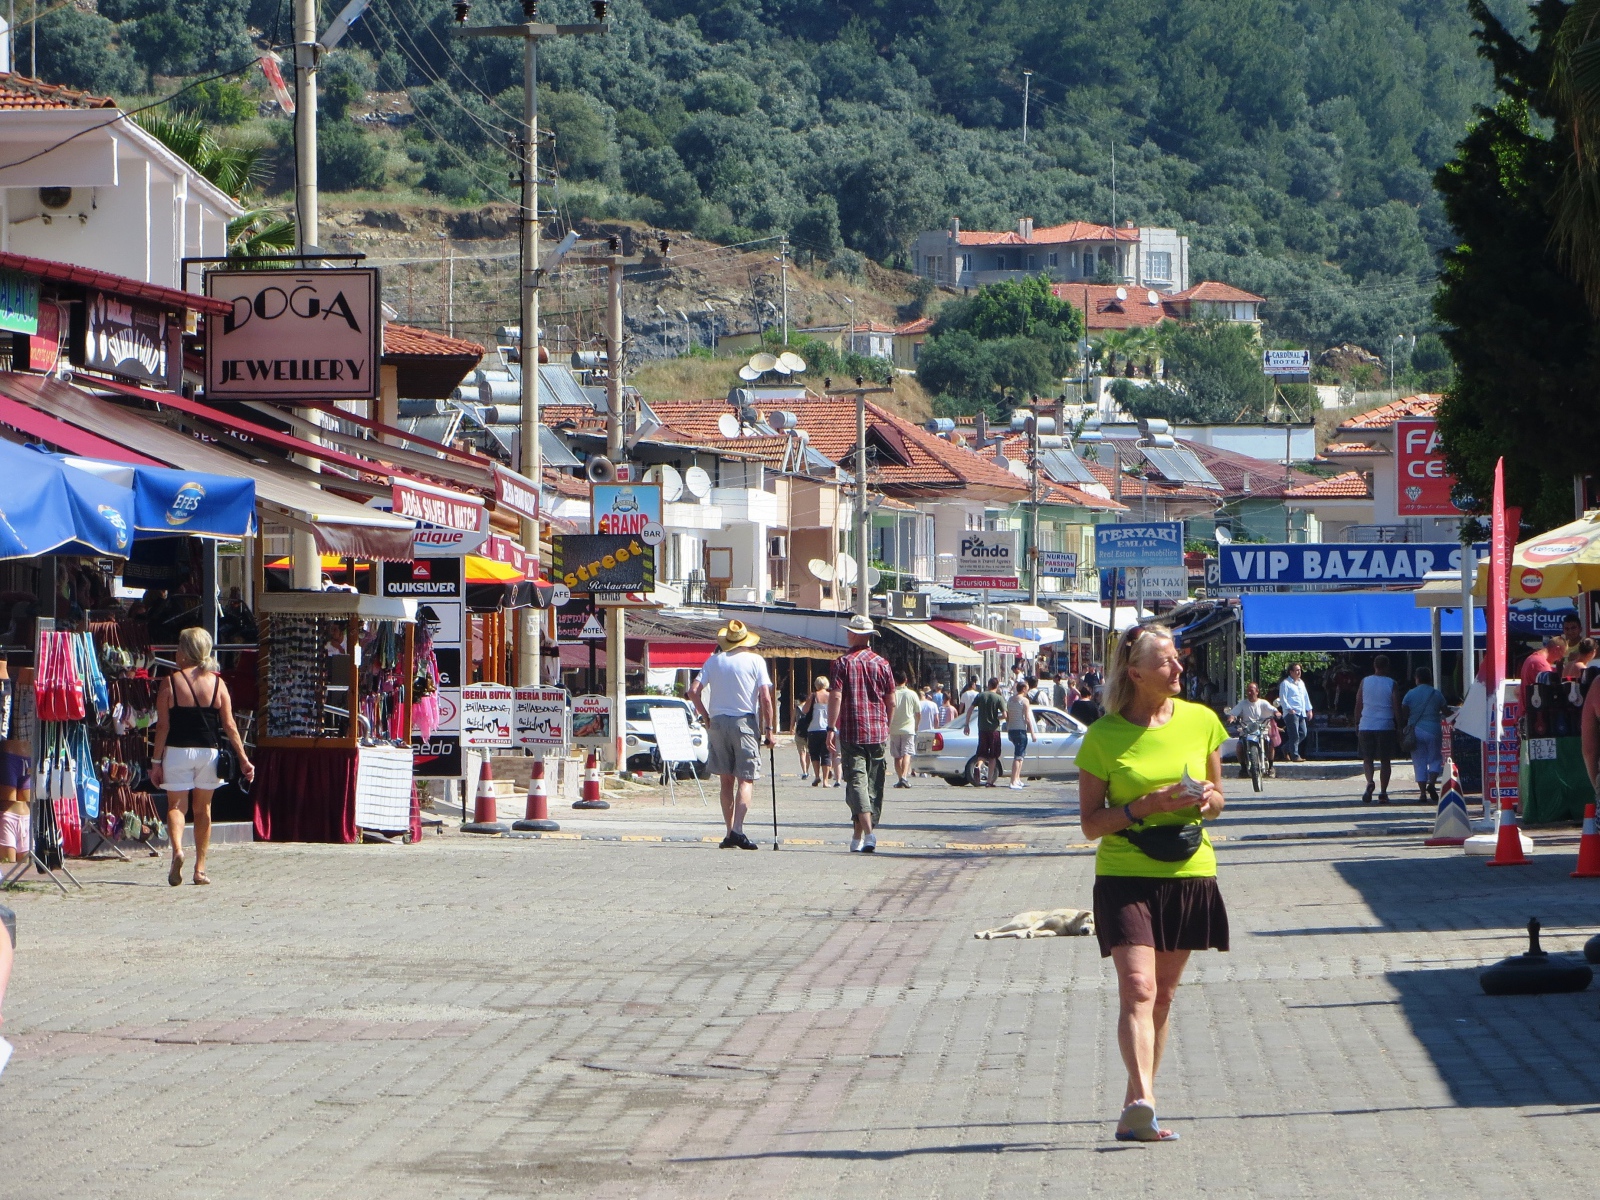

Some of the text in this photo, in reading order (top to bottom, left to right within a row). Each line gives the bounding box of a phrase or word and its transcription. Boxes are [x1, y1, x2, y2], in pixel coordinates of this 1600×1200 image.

[219, 358, 365, 384] JEWELLERY
[172, 494, 202, 510] EFES
[401, 489, 423, 519] DOĞA
[422, 496, 447, 525] SILVER
[453, 504, 477, 531] WATCH
[600, 513, 649, 535] GRAND
[1098, 524, 1178, 545] TERYAKİ
[961, 539, 1009, 558] Panda
[1117, 540, 1158, 548] EMLAK
[1115, 550, 1136, 558] Estate
[563, 538, 643, 588] street
[1231, 551, 1289, 580] VIP
[1303, 550, 1435, 579] BAZAAR
[387, 582, 456, 593] QUIKSILVER
[588, 580, 643, 590] Restaurant
[956, 579, 990, 587] Excursions
[991, 579, 996, 587] &
[1162, 578, 1184, 587] TAXI
[1342, 638, 1391, 648] VIP
[489, 689, 512, 699] BUTİK
[541, 691, 564, 701] BUTİK
